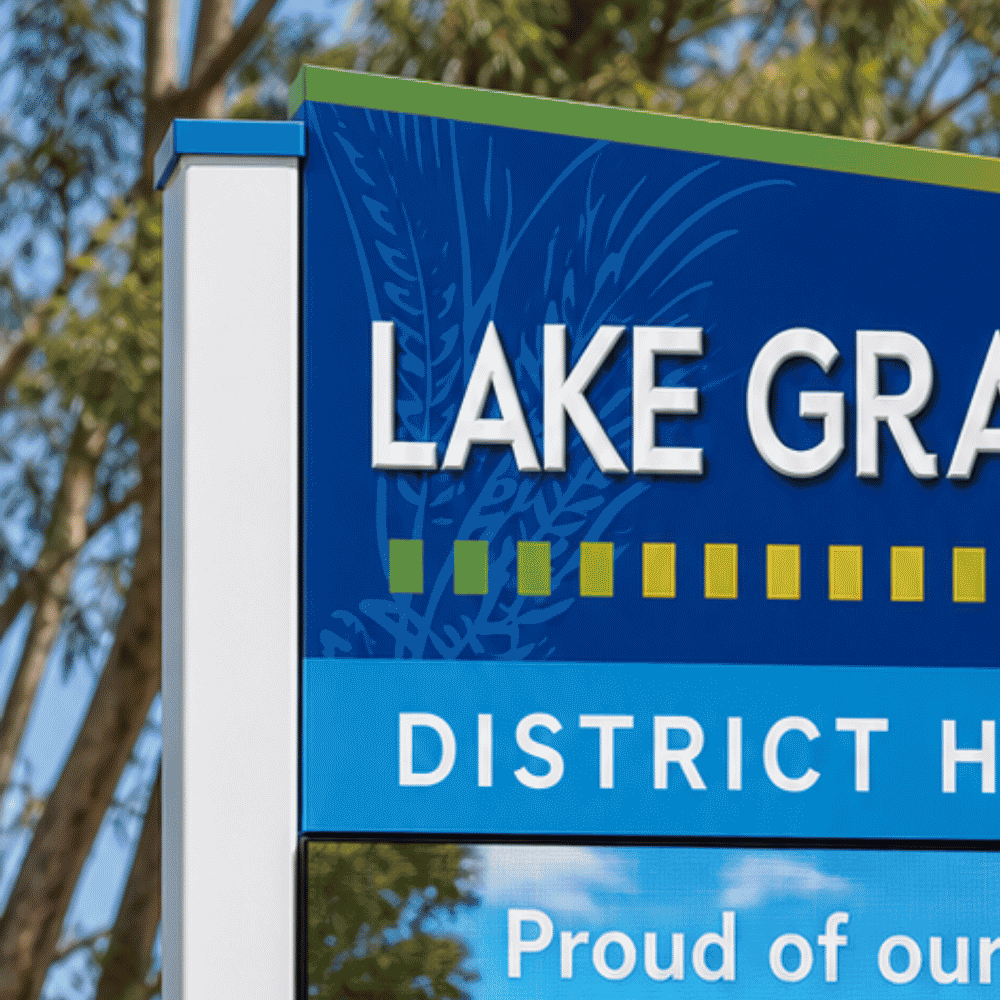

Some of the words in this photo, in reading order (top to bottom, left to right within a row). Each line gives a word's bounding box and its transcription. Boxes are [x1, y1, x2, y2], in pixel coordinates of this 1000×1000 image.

[371, 320, 704, 474] LAKE
[398, 712, 889, 792] DISTRICT
[506, 908, 737, 981] Proud
[768, 911, 850, 983] of
